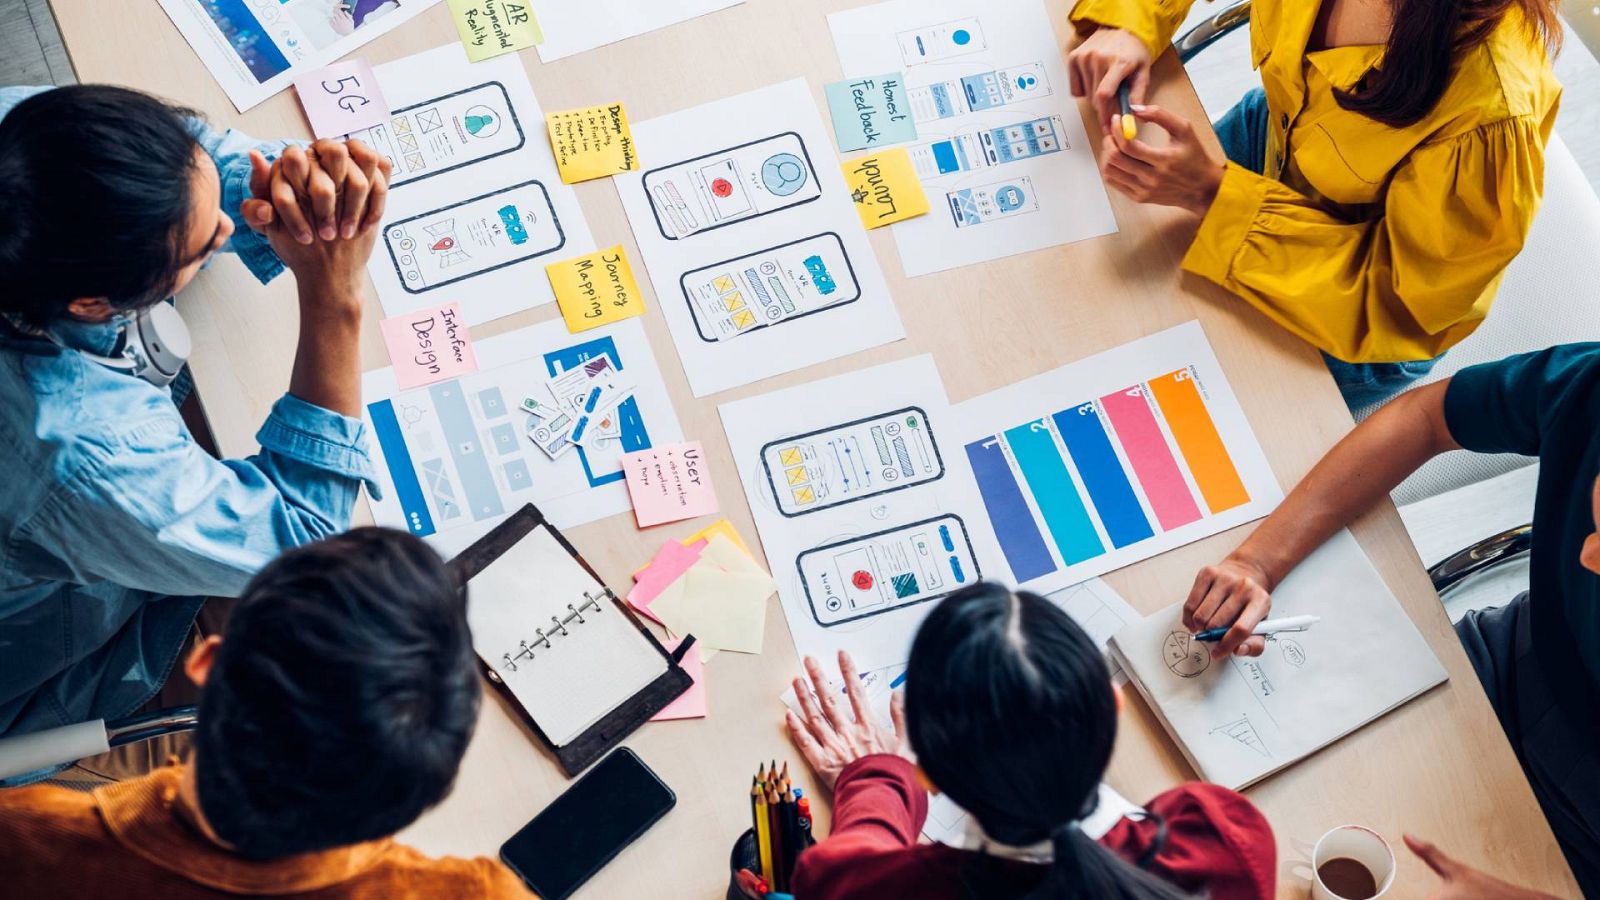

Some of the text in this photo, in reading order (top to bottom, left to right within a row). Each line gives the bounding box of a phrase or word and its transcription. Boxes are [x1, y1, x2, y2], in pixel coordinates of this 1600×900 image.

[465, 8, 488, 46] Reality
[482, 0, 514, 49] ugmented
[506, 4, 529, 25] AR
[321, 75, 370, 113] 5G
[850, 79, 881, 144] Feedback
[882, 80, 907, 122] Honest
[608, 105, 622, 135] Design
[854, 158, 897, 219] Launch
[575, 259, 603, 319] Mapping
[602, 254, 628, 307] Journey
[799, 274, 809, 287] VR
[411, 316, 441, 374] Design
[440, 308, 466, 363] Interface
[1125, 384, 1142, 398] 4
[1173, 370, 1191, 384] 5
[1030, 418, 1048, 434] 2
[1078, 403, 1095, 417] 3
[982, 438, 1001, 451] 1
[683, 449, 701, 486] User
